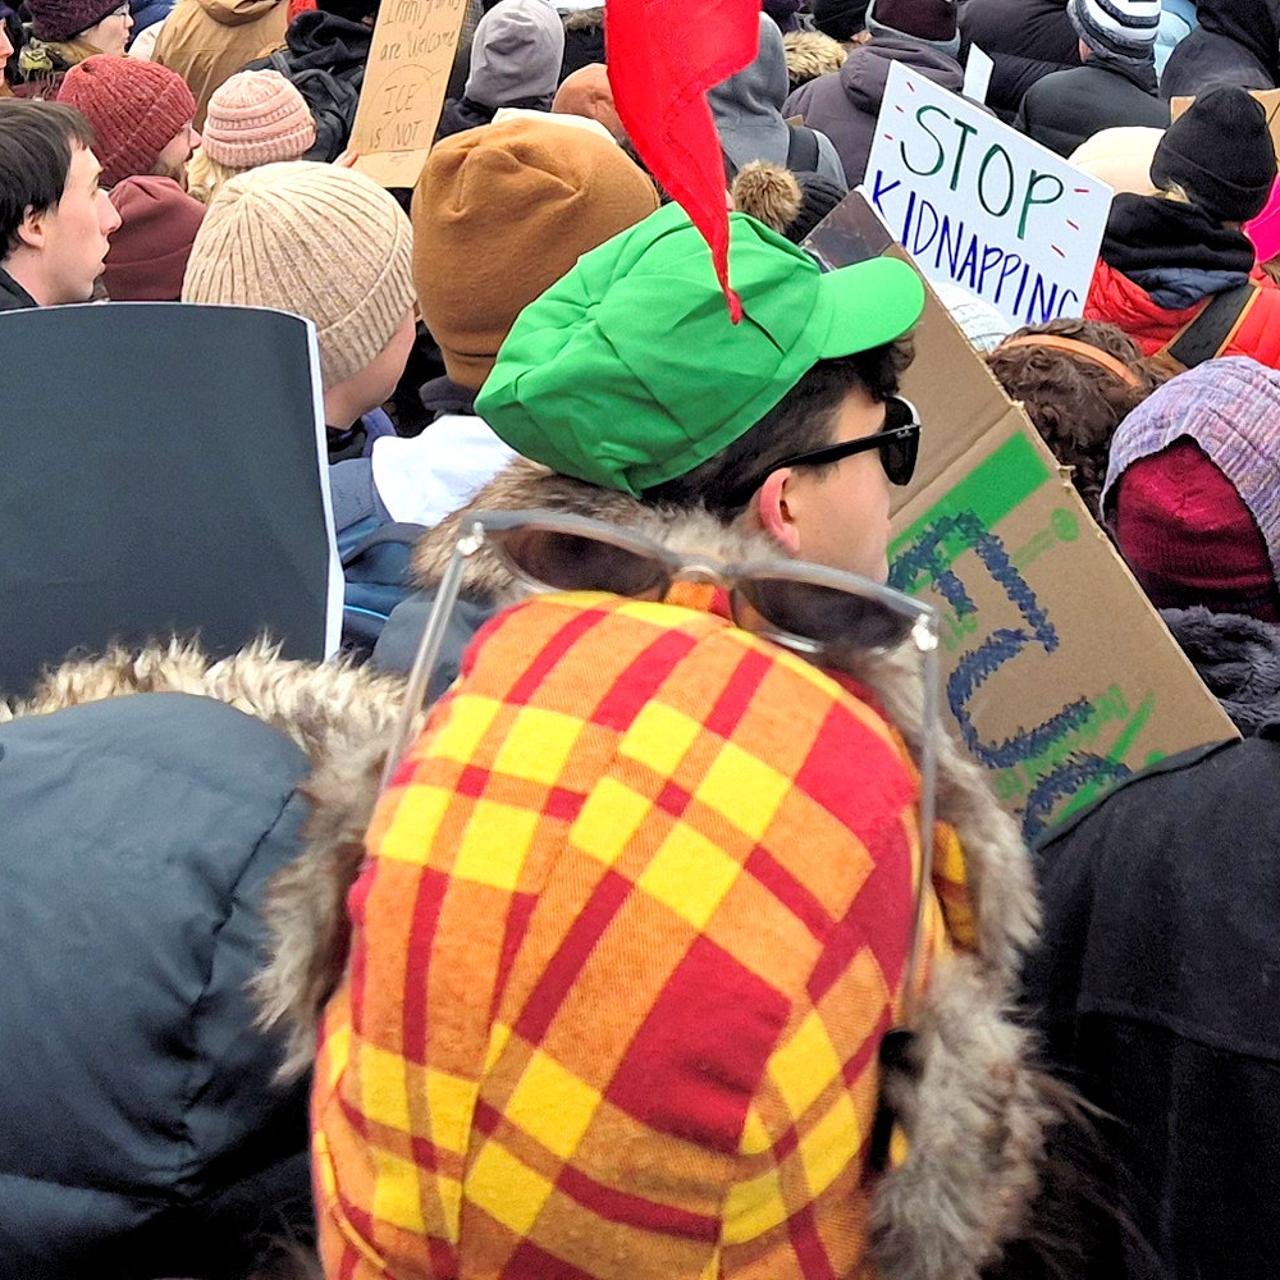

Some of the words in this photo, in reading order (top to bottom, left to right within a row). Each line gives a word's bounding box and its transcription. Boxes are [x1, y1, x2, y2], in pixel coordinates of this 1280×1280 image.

[380, 43, 402, 62] are
[383, 83, 418, 115] ICE
[391, 119, 423, 149] NOT
[900, 105, 1064, 240] STOP
